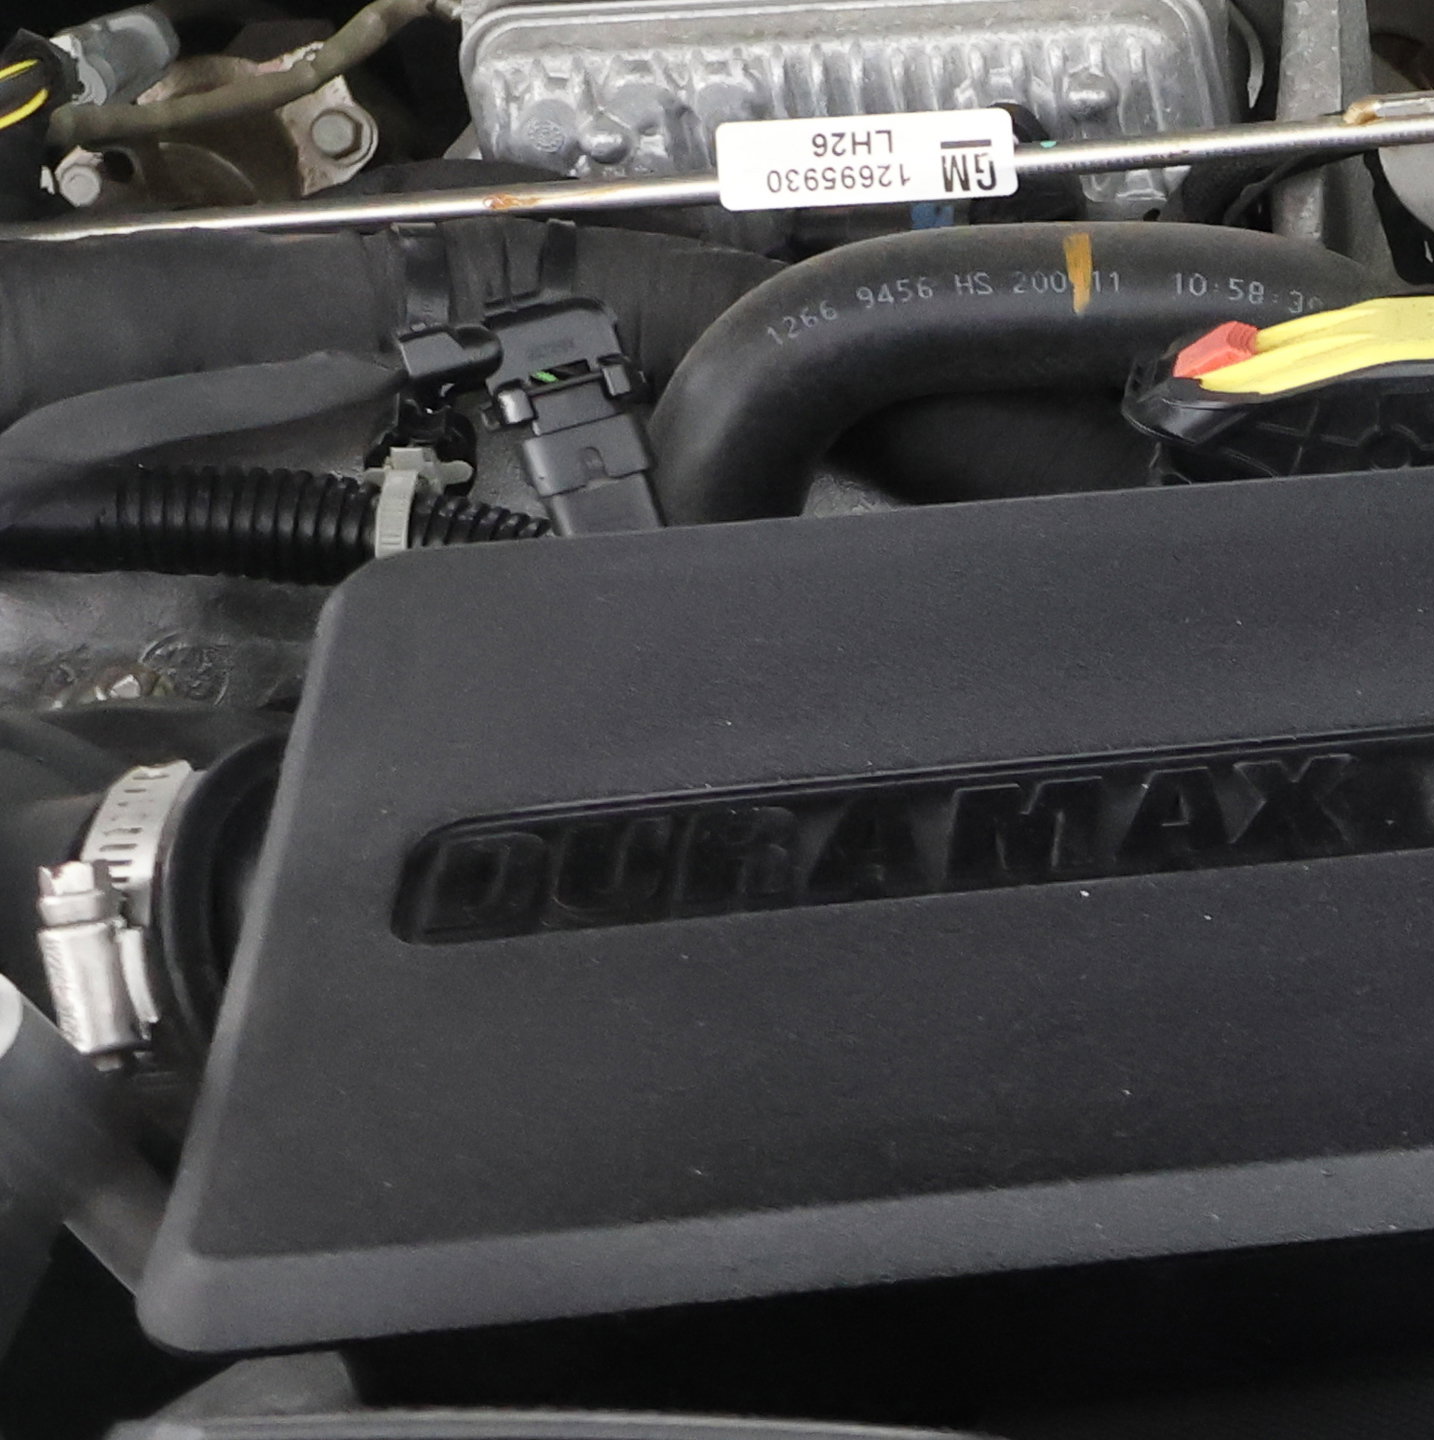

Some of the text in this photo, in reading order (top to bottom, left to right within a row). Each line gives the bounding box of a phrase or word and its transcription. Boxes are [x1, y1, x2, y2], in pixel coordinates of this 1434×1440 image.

[811, 129, 894, 157] LH26
[766, 164, 911, 194] 12695930
[939, 153, 998, 193] GM
[765, 300, 839, 346] 1266
[854, 275, 934, 308] 9456
[953, 271, 994, 296] HS
[1012, 270, 1122, 294] 20011
[420, 754, 1356, 935] DURAMAX
